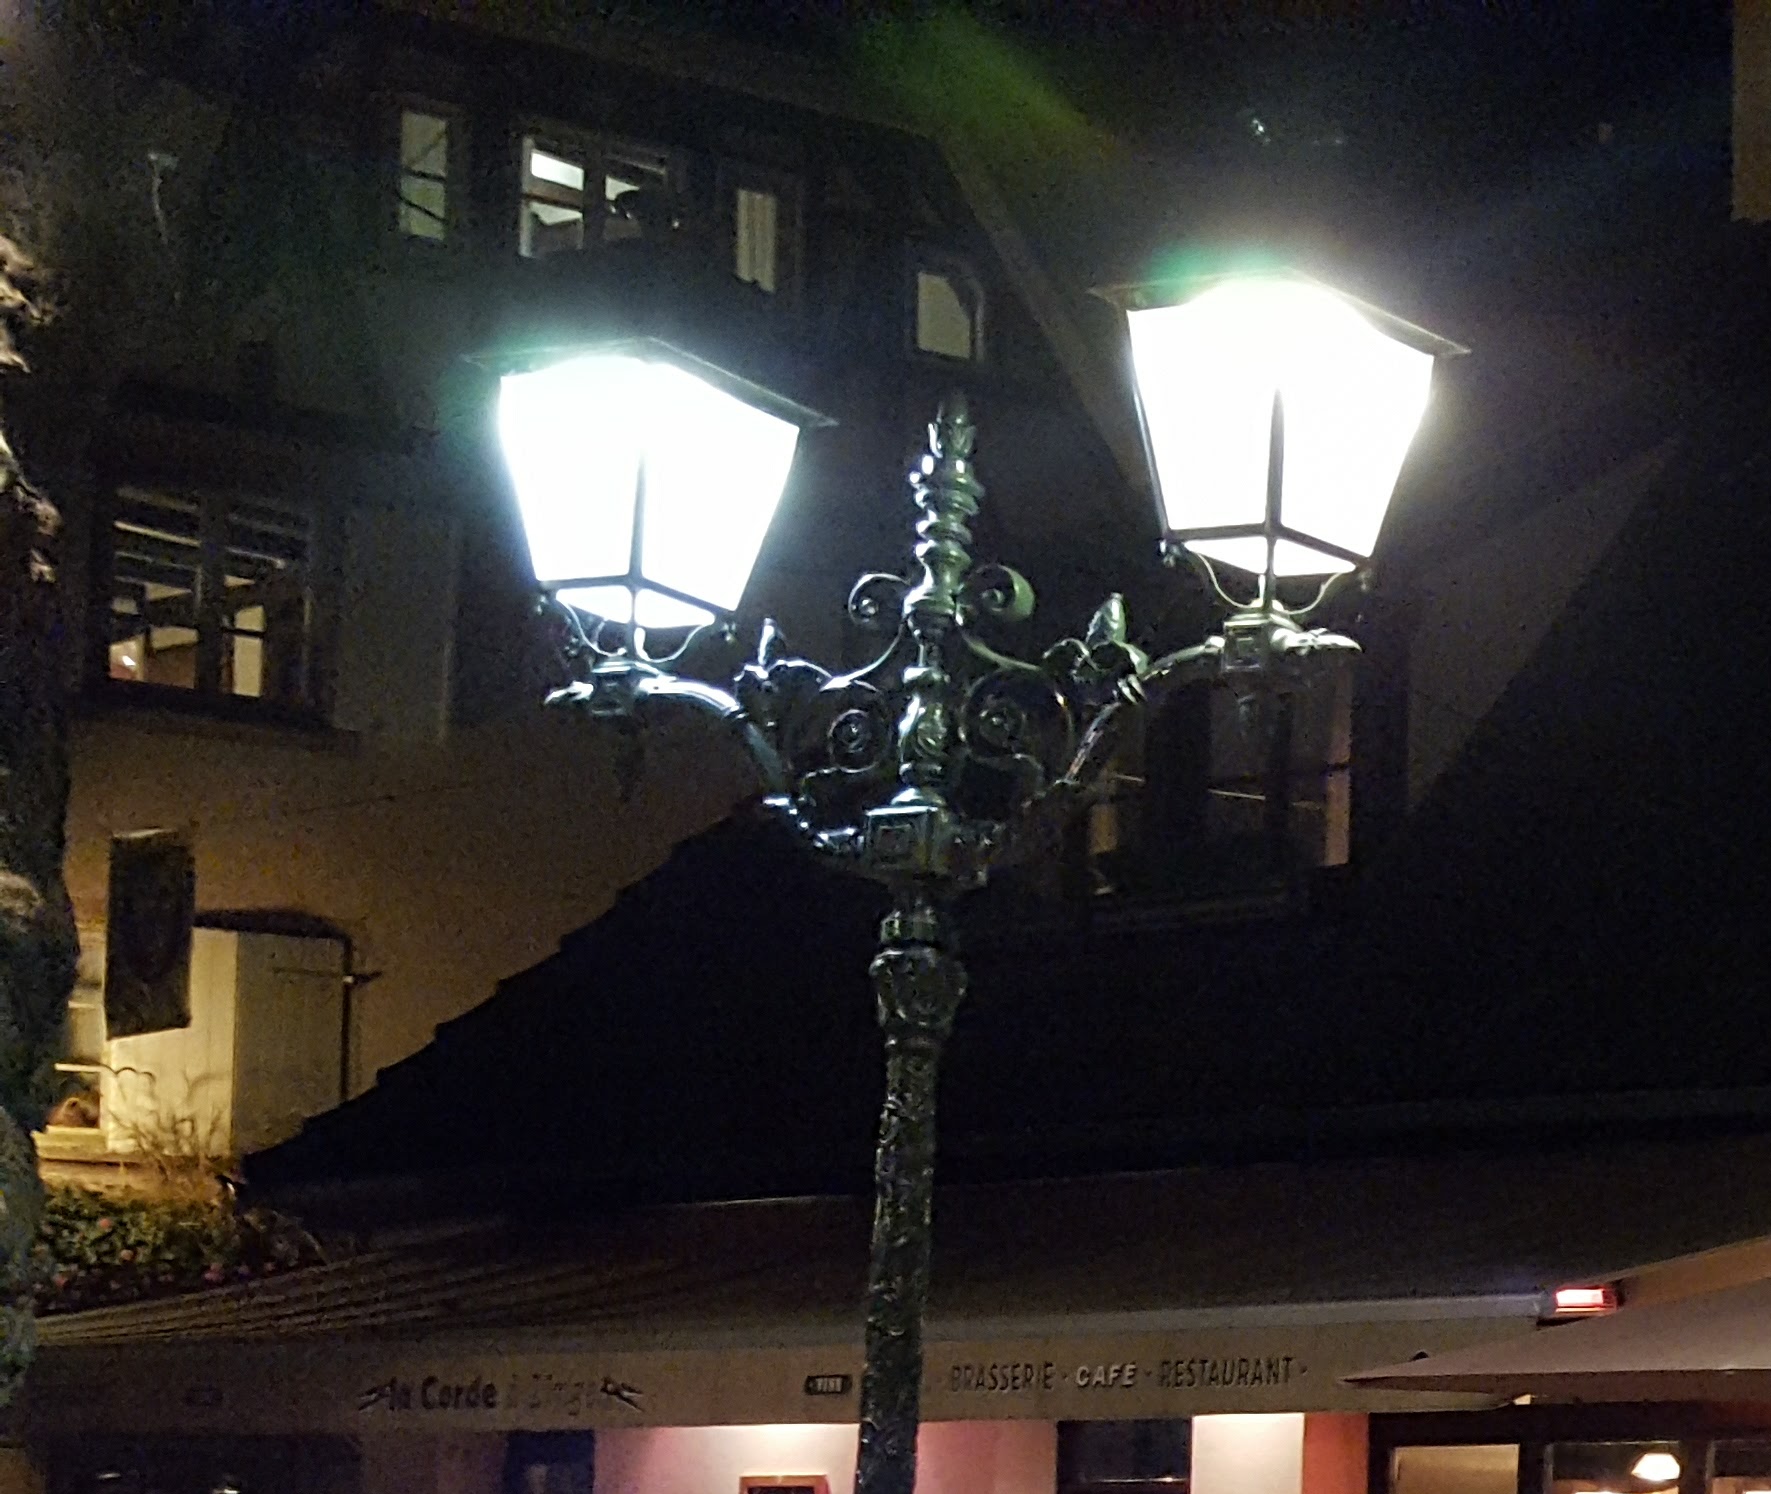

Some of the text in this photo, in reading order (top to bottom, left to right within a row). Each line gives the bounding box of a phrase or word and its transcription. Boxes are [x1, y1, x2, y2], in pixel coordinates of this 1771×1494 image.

[951, 1361, 1055, 1392] BRASSERIE
[1158, 1356, 1294, 1388] RESTAURANT
[422, 1375, 496, 1410] Corde
